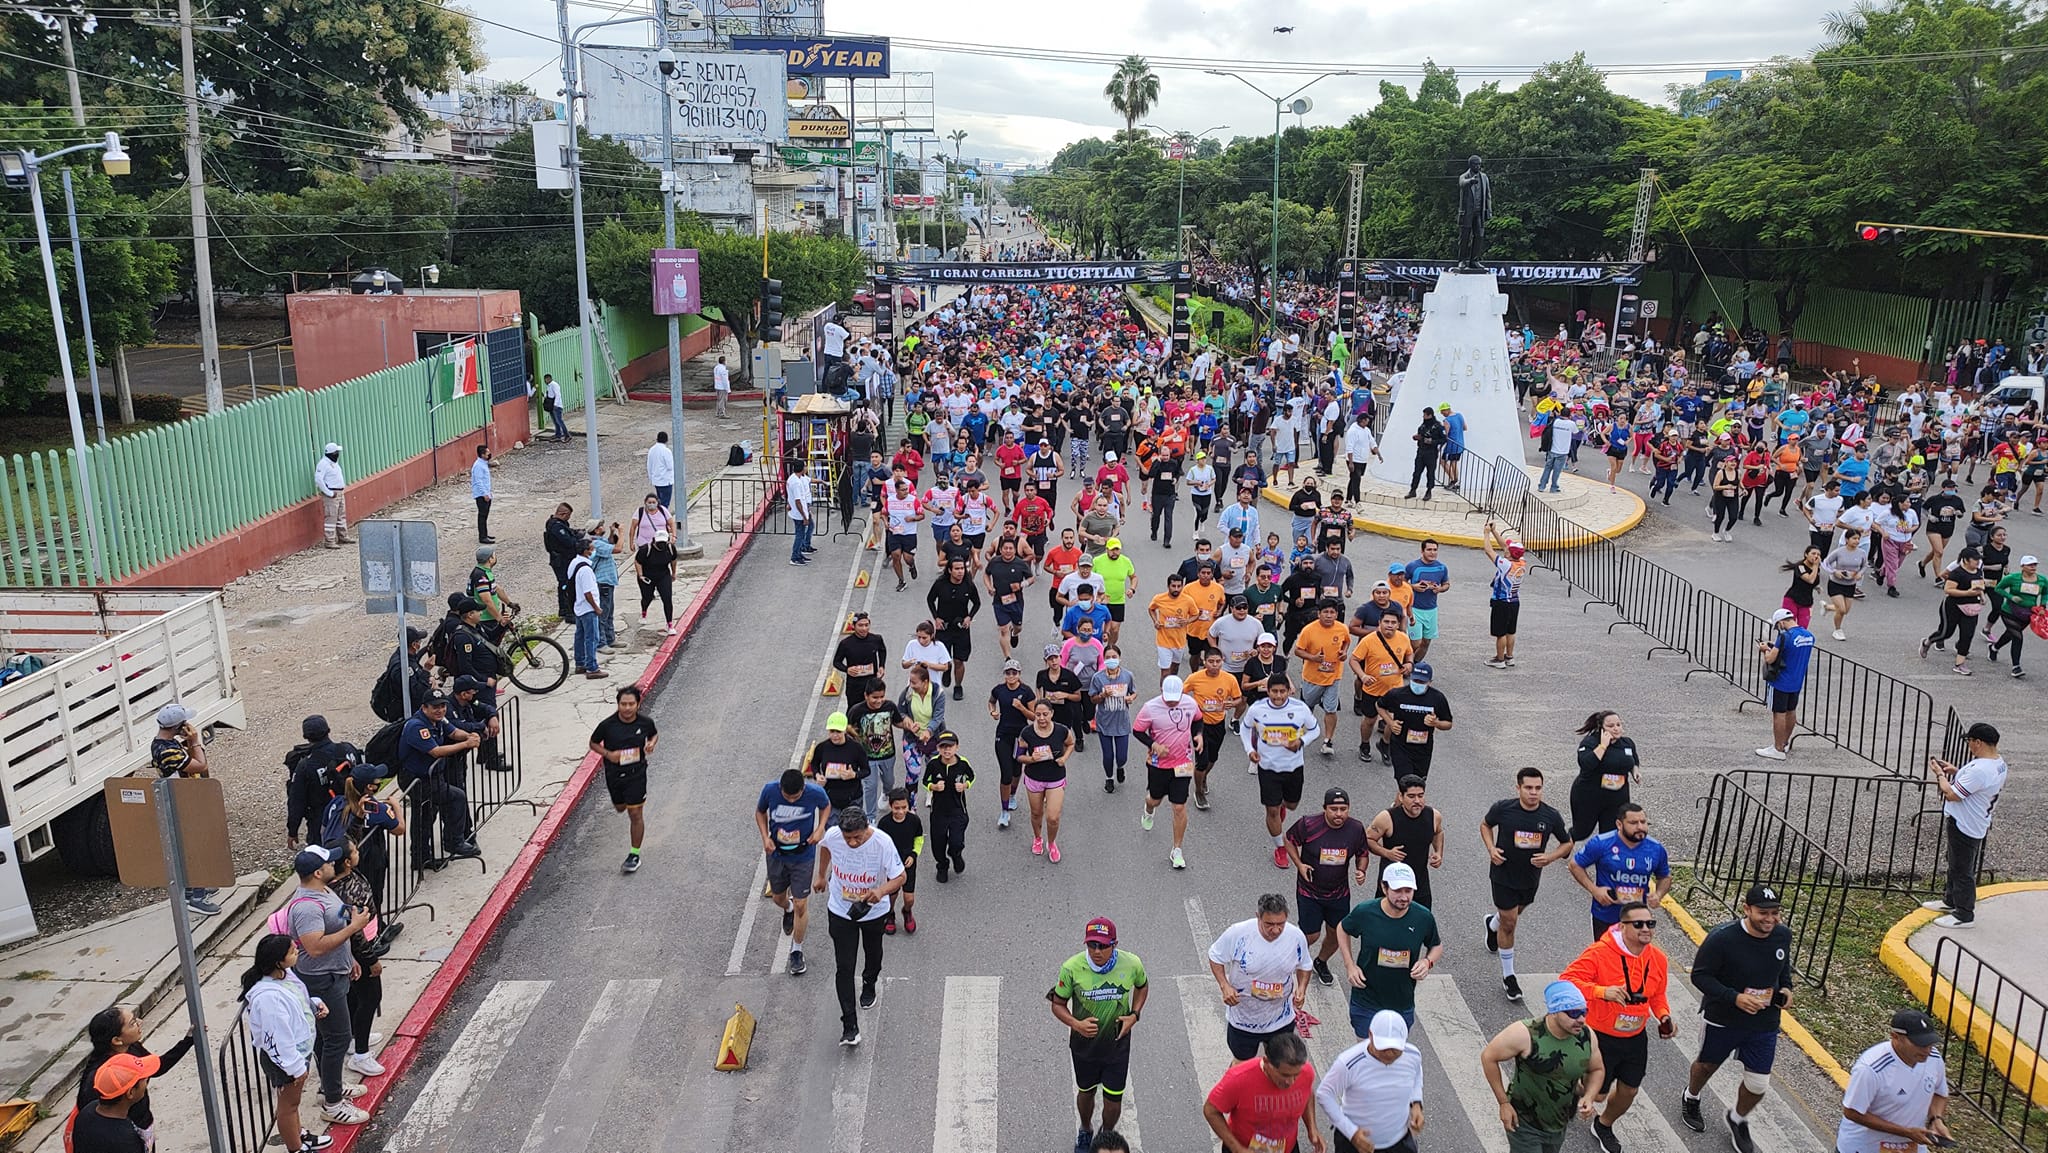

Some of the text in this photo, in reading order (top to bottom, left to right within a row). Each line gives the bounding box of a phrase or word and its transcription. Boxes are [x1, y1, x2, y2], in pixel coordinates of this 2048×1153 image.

[696, 62, 748, 86] RENTA
[800, 124, 847, 132] DUNLOP
[930, 266, 1137, 280] II GRAN CARRERA TUCHTLAN
[1396, 266, 1406, 274] II
[1410, 266, 1445, 276] GRAN
[1511, 266, 1602, 279] TUCHTLAN
[1610, 870, 1648, 887] Jeep
